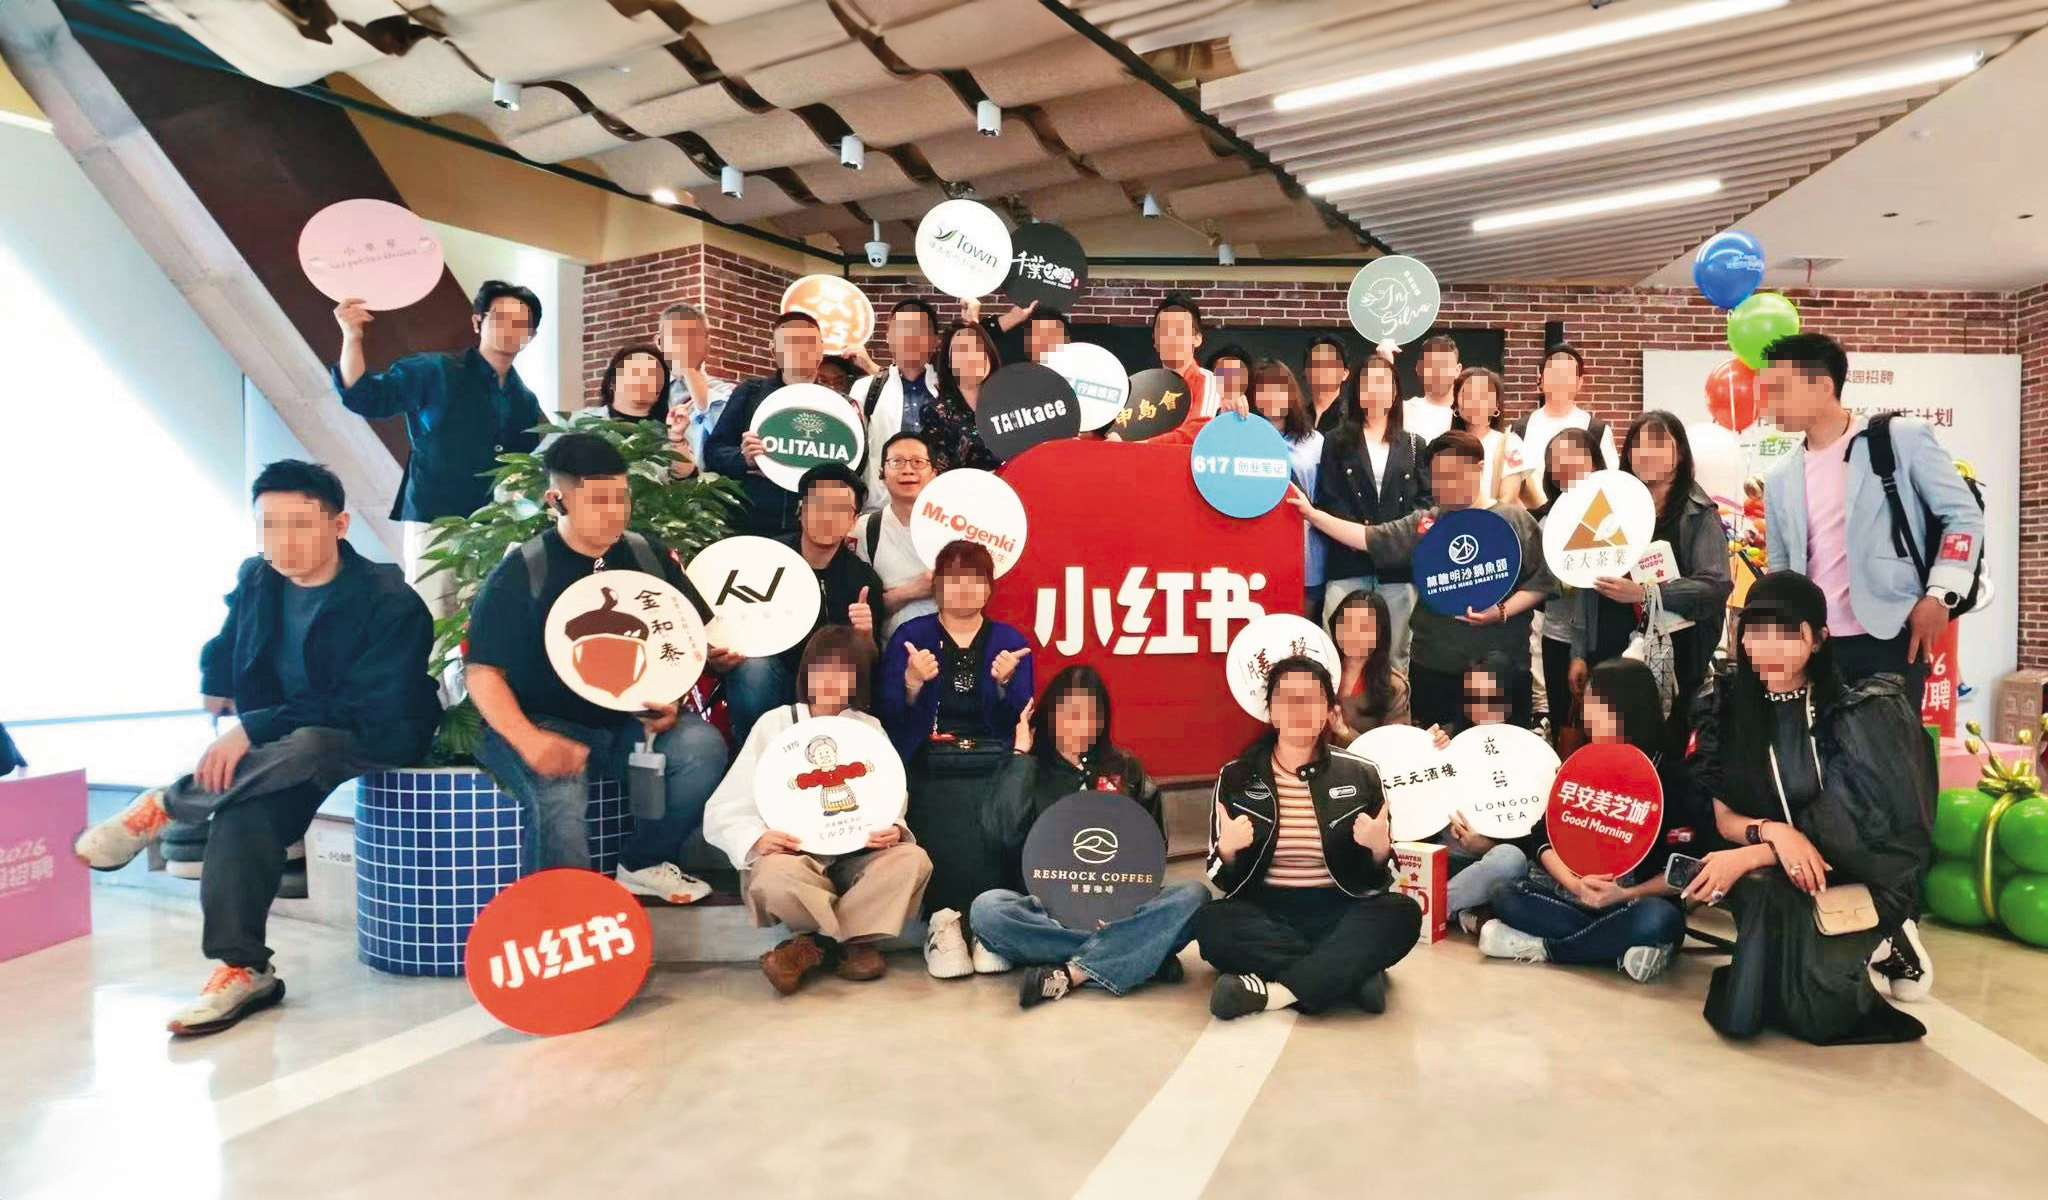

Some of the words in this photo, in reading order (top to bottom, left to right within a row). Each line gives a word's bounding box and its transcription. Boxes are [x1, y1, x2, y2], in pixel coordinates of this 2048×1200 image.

[956, 233, 998, 269] Town
[762, 436, 850, 461] OLITALIA
[1193, 455, 1231, 475] 617
[1238, 461, 1285, 475] 创业笔记
[1034, 566, 1266, 656] 小红书
[1922, 678, 1951, 711] 聘
[782, 740, 801, 754] 1970
[1474, 795, 1540, 812] LONGOO
[1558, 780, 1652, 826] 早安美芝城
[1495, 811, 1527, 823] TEA
[1561, 810, 1589, 829] Good
[1588, 818, 1633, 844] Morning
[1033, 869, 1097, 881] RESHOCK
[1102, 872, 1153, 883] COFFEE
[489, 912, 635, 989] 小红书
